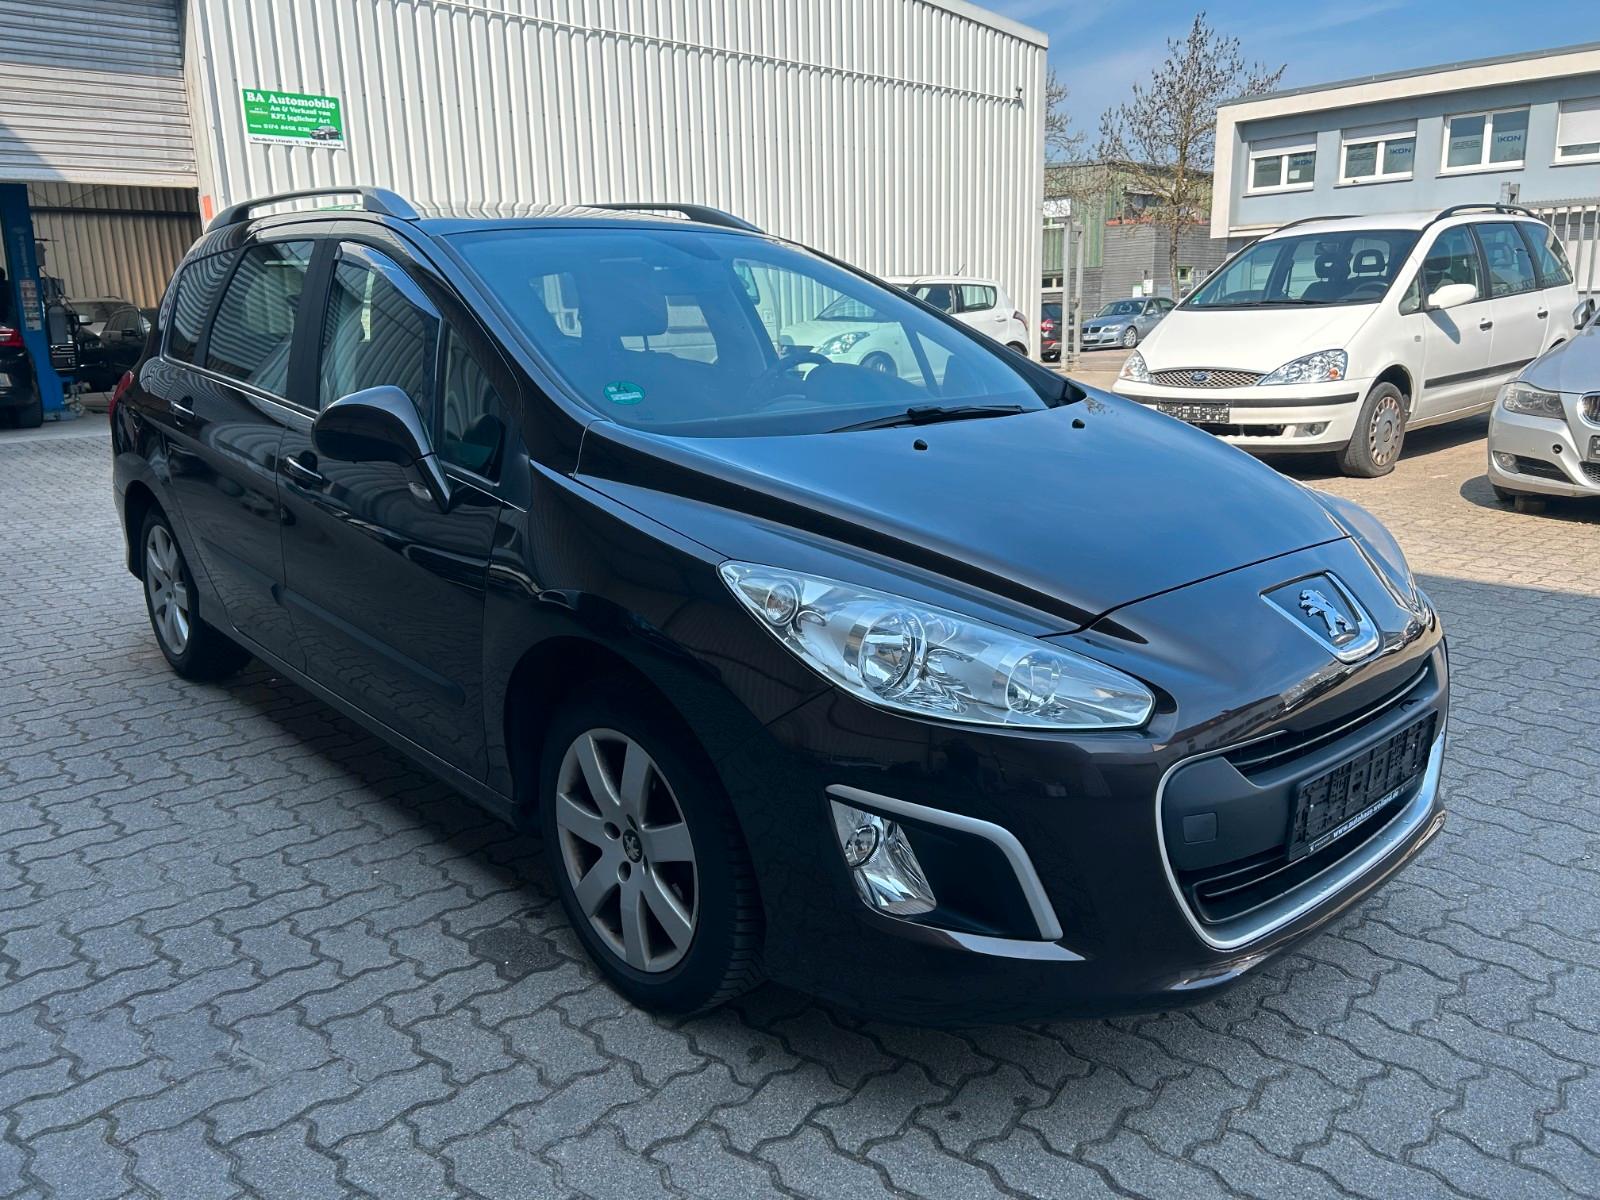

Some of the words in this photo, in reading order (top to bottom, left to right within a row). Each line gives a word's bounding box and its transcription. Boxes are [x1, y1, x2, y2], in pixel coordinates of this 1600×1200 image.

[246, 92, 265, 103] BA
[269, 94, 336, 109] Automobile
[289, 107, 317, 115] Verkauf
[287, 115, 317, 123] jeglicher
